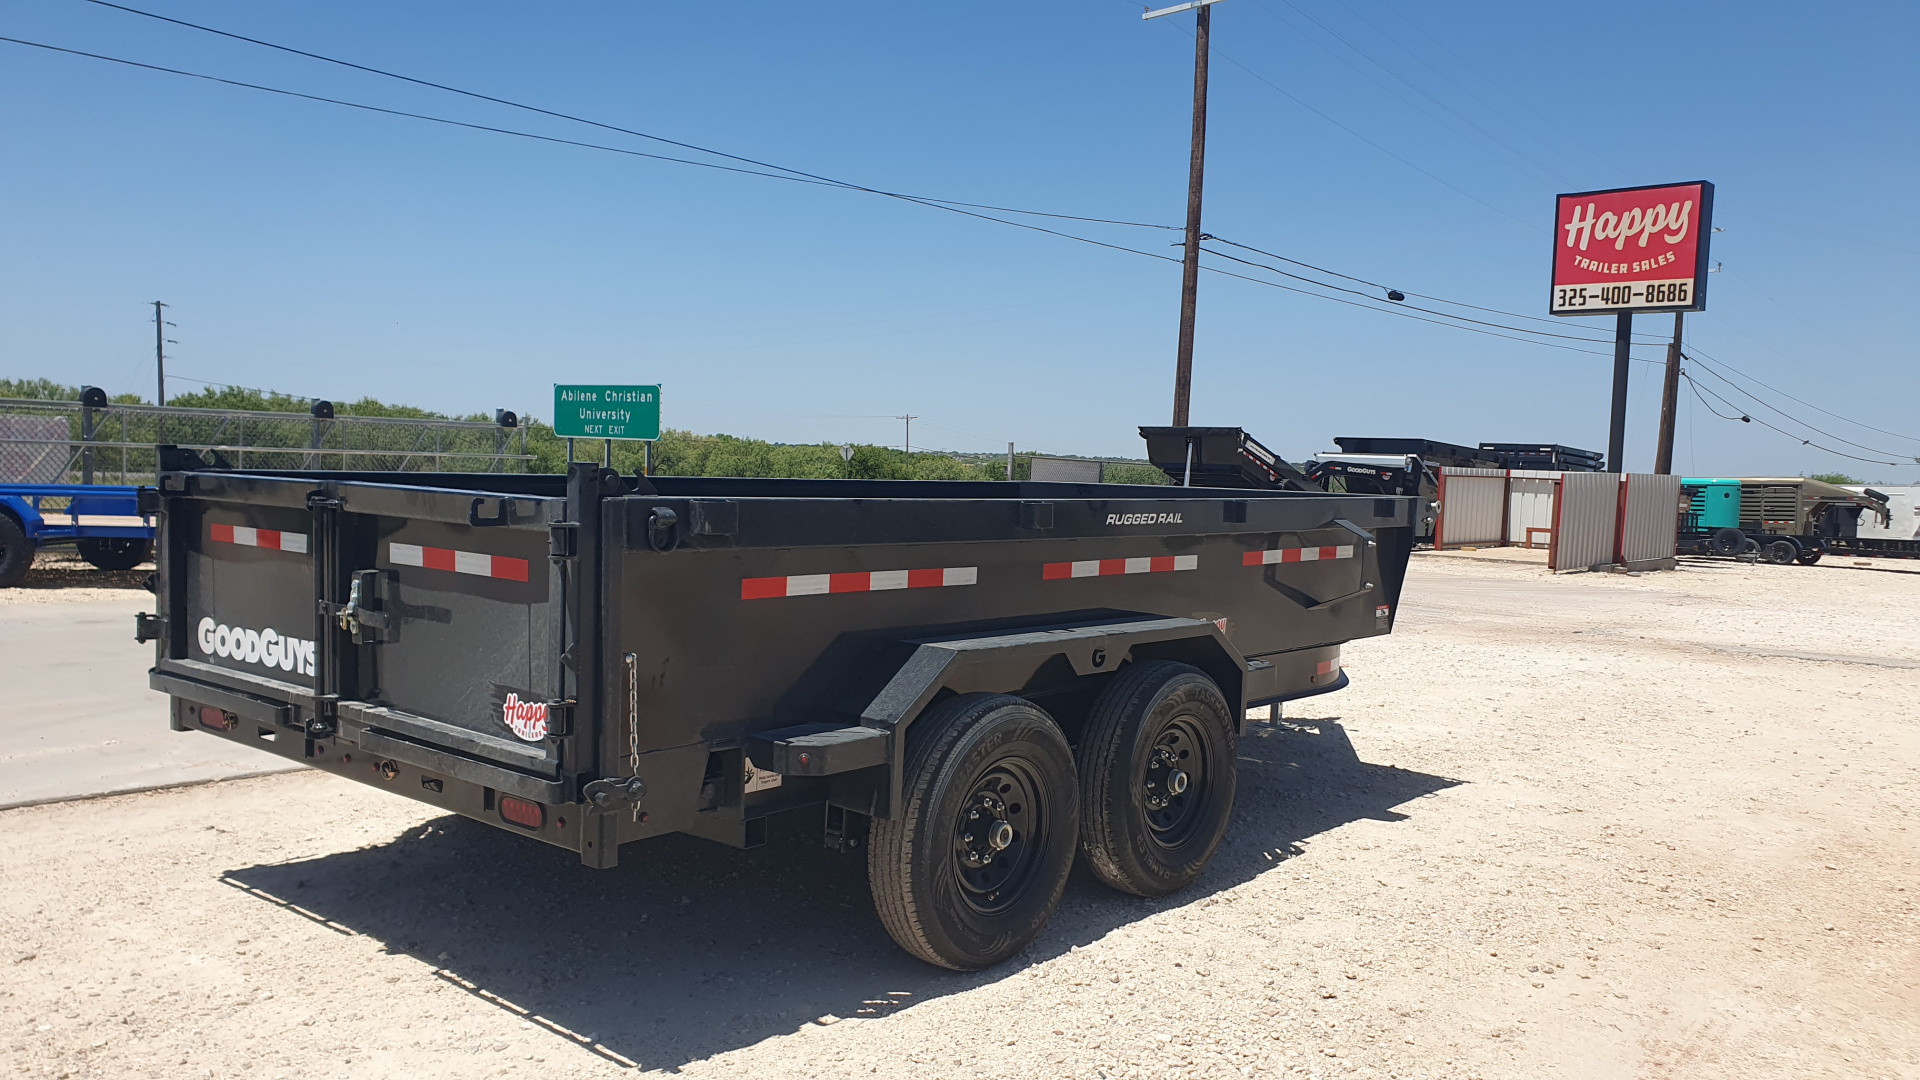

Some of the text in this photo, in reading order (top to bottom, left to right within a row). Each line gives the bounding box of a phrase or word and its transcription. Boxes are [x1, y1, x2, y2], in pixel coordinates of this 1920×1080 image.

[1565, 200, 1692, 251] Happy
[1574, 251, 1676, 274] TRAILER SALES
[1558, 283, 1688, 307] 325-400-8686
[561, 390, 653, 402] Abilene Christian
[579, 408, 631, 423] University
[584, 425, 625, 435] NEXT EXIT
[1106, 513, 1183, 525] RUGGED RAIL
[514, 725, 542, 739] TRAILERS
[1136, 832, 1171, 880] RAMBLER
